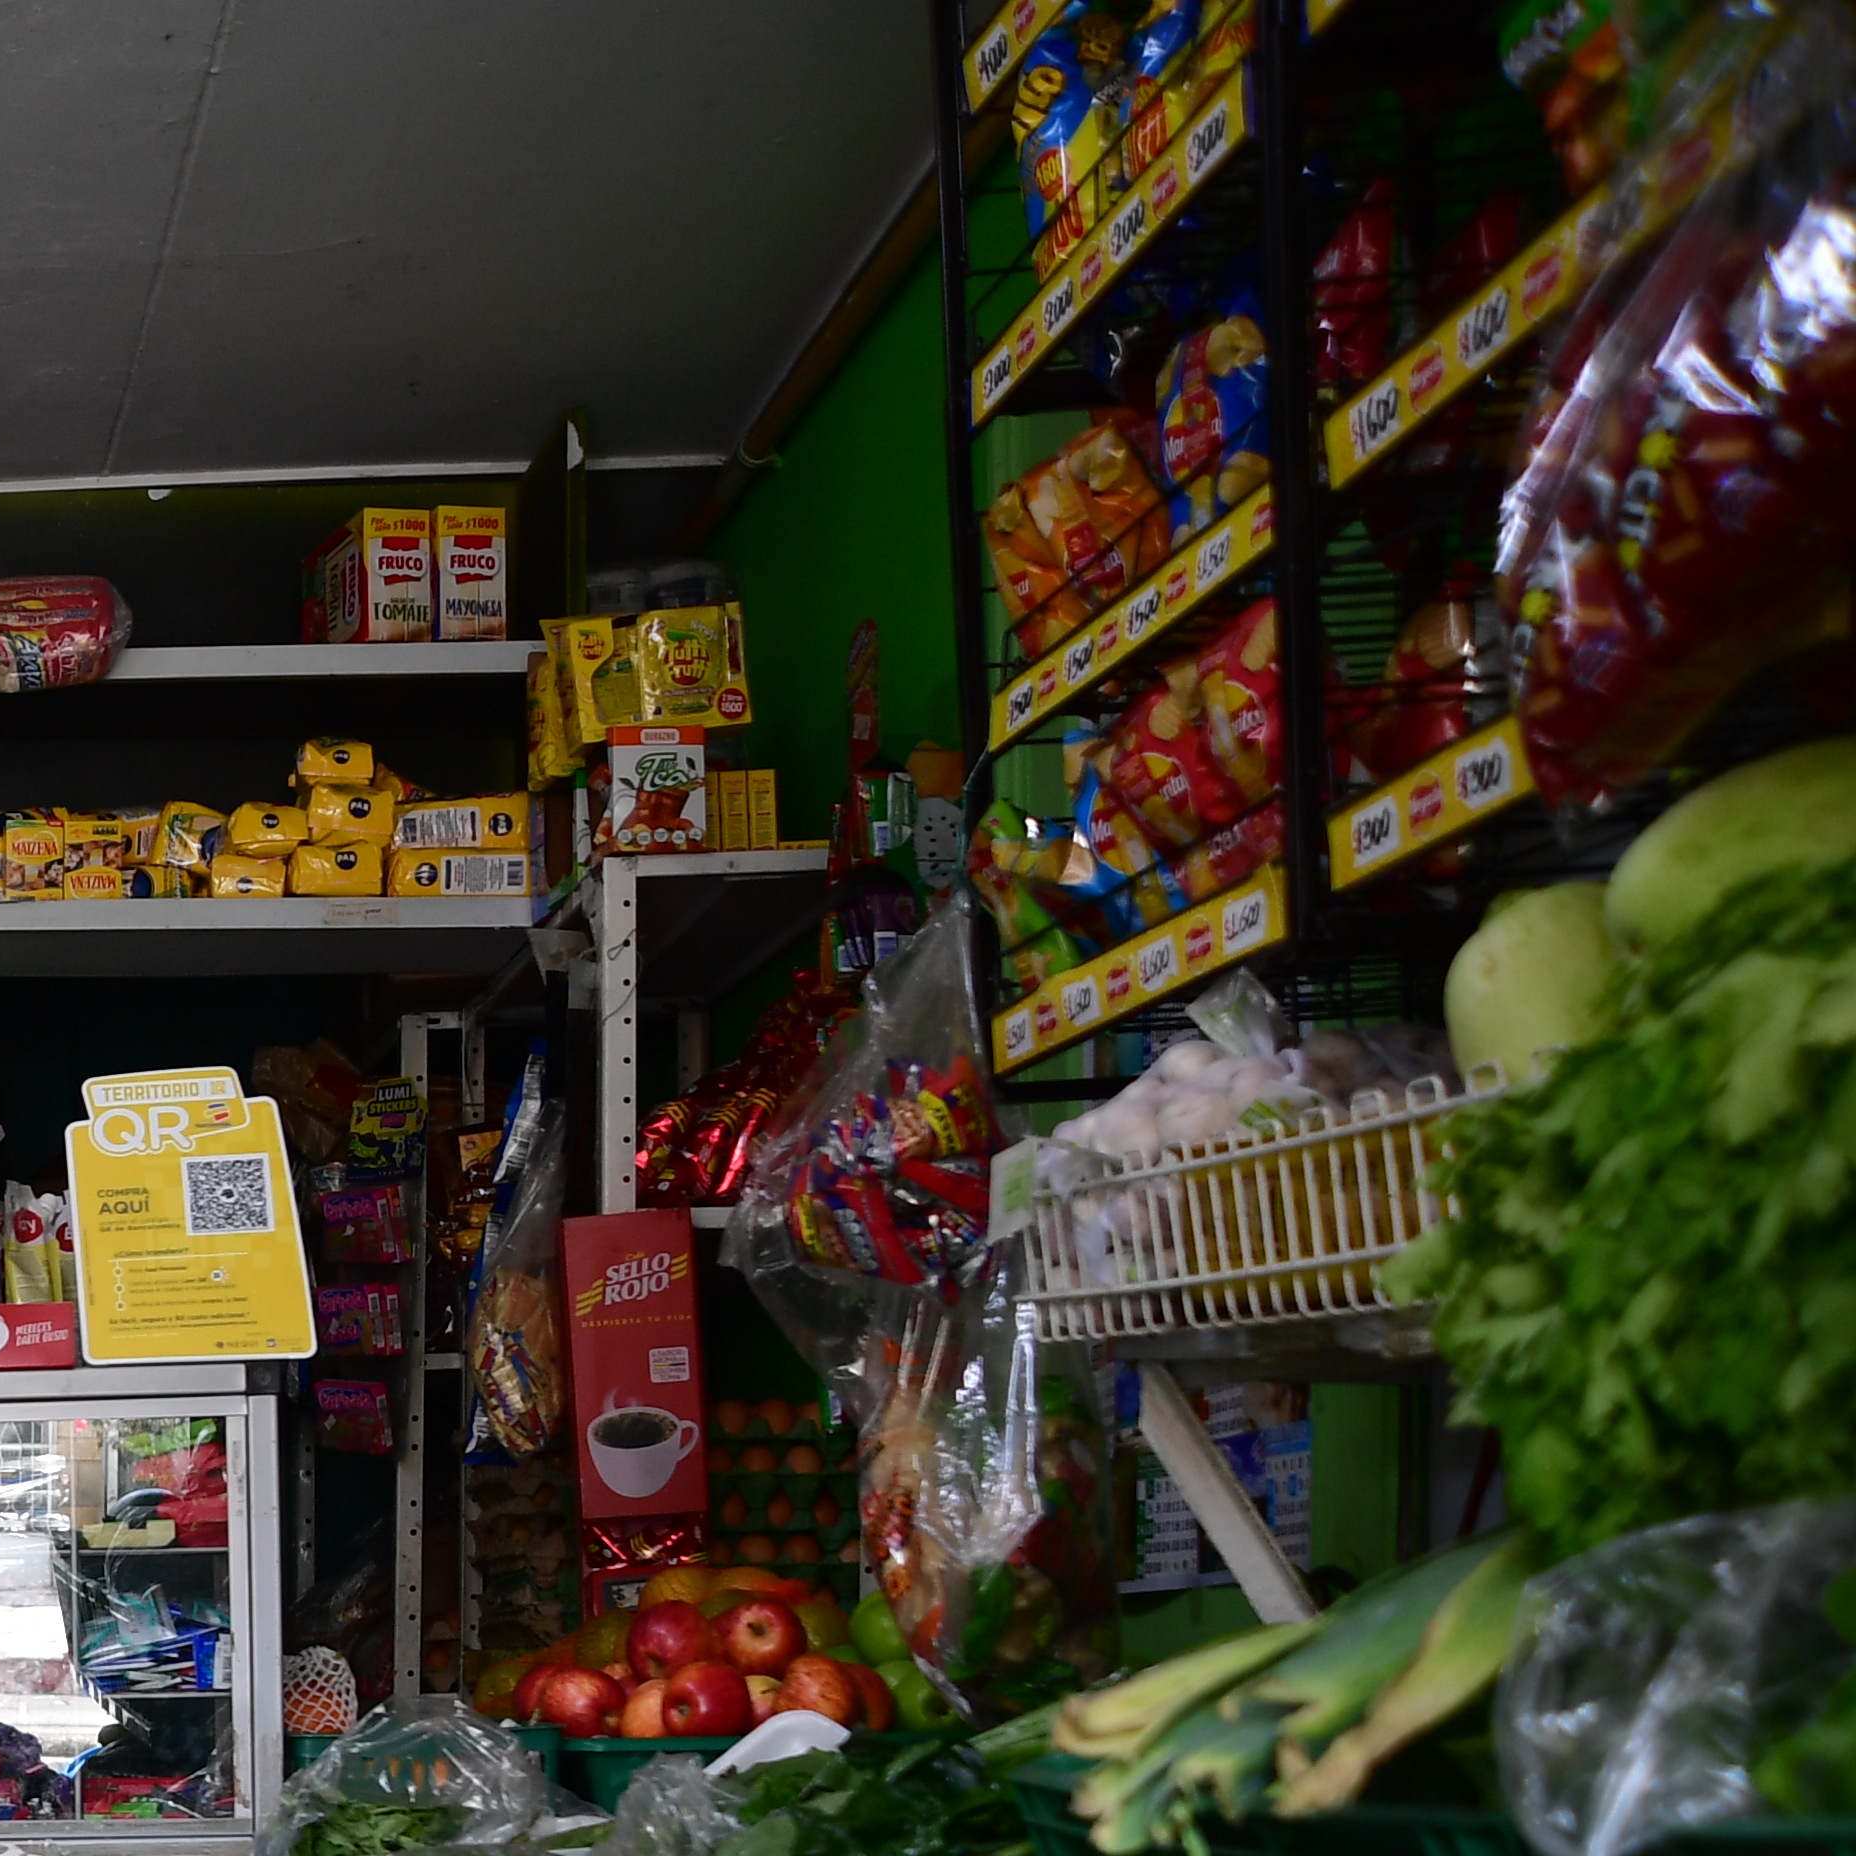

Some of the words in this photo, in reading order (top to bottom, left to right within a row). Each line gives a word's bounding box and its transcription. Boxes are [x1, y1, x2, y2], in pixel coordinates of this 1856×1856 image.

[393, 518, 426, 532] $1000
[465, 517, 499, 531] $1000
[378, 555, 423, 571] FRUCO
[450, 554, 495, 570] FRUCO
[345, 553, 357, 618] FRUCO
[373, 602, 430, 623] TOMATE
[445, 597, 503, 617] MAYONESA
[350, 801, 370, 812] PAN
[10, 840, 59, 857] MAIZENA
[336, 853, 356, 865] PAN
[69, 874, 117, 890] MAIZENA
[101, 1081, 200, 1104] TERRITORIO
[379, 1085, 410, 1102] LUMI
[369, 1098, 418, 1116] STICKERS
[93, 1106, 192, 1151] QR
[97, 1187, 149, 1199] COMPRA
[98, 1196, 150, 1215] AQUÍ
[605, 1252, 671, 1285] SELLO
[604, 1271, 670, 1306] ROJO
[15, 1320, 52, 1336] MERECES
[581, 1317, 641, 1328] DESPIERTA
[16, 1333, 41, 1347] DARTE
[43, 1329, 70, 1344] GUSTO
